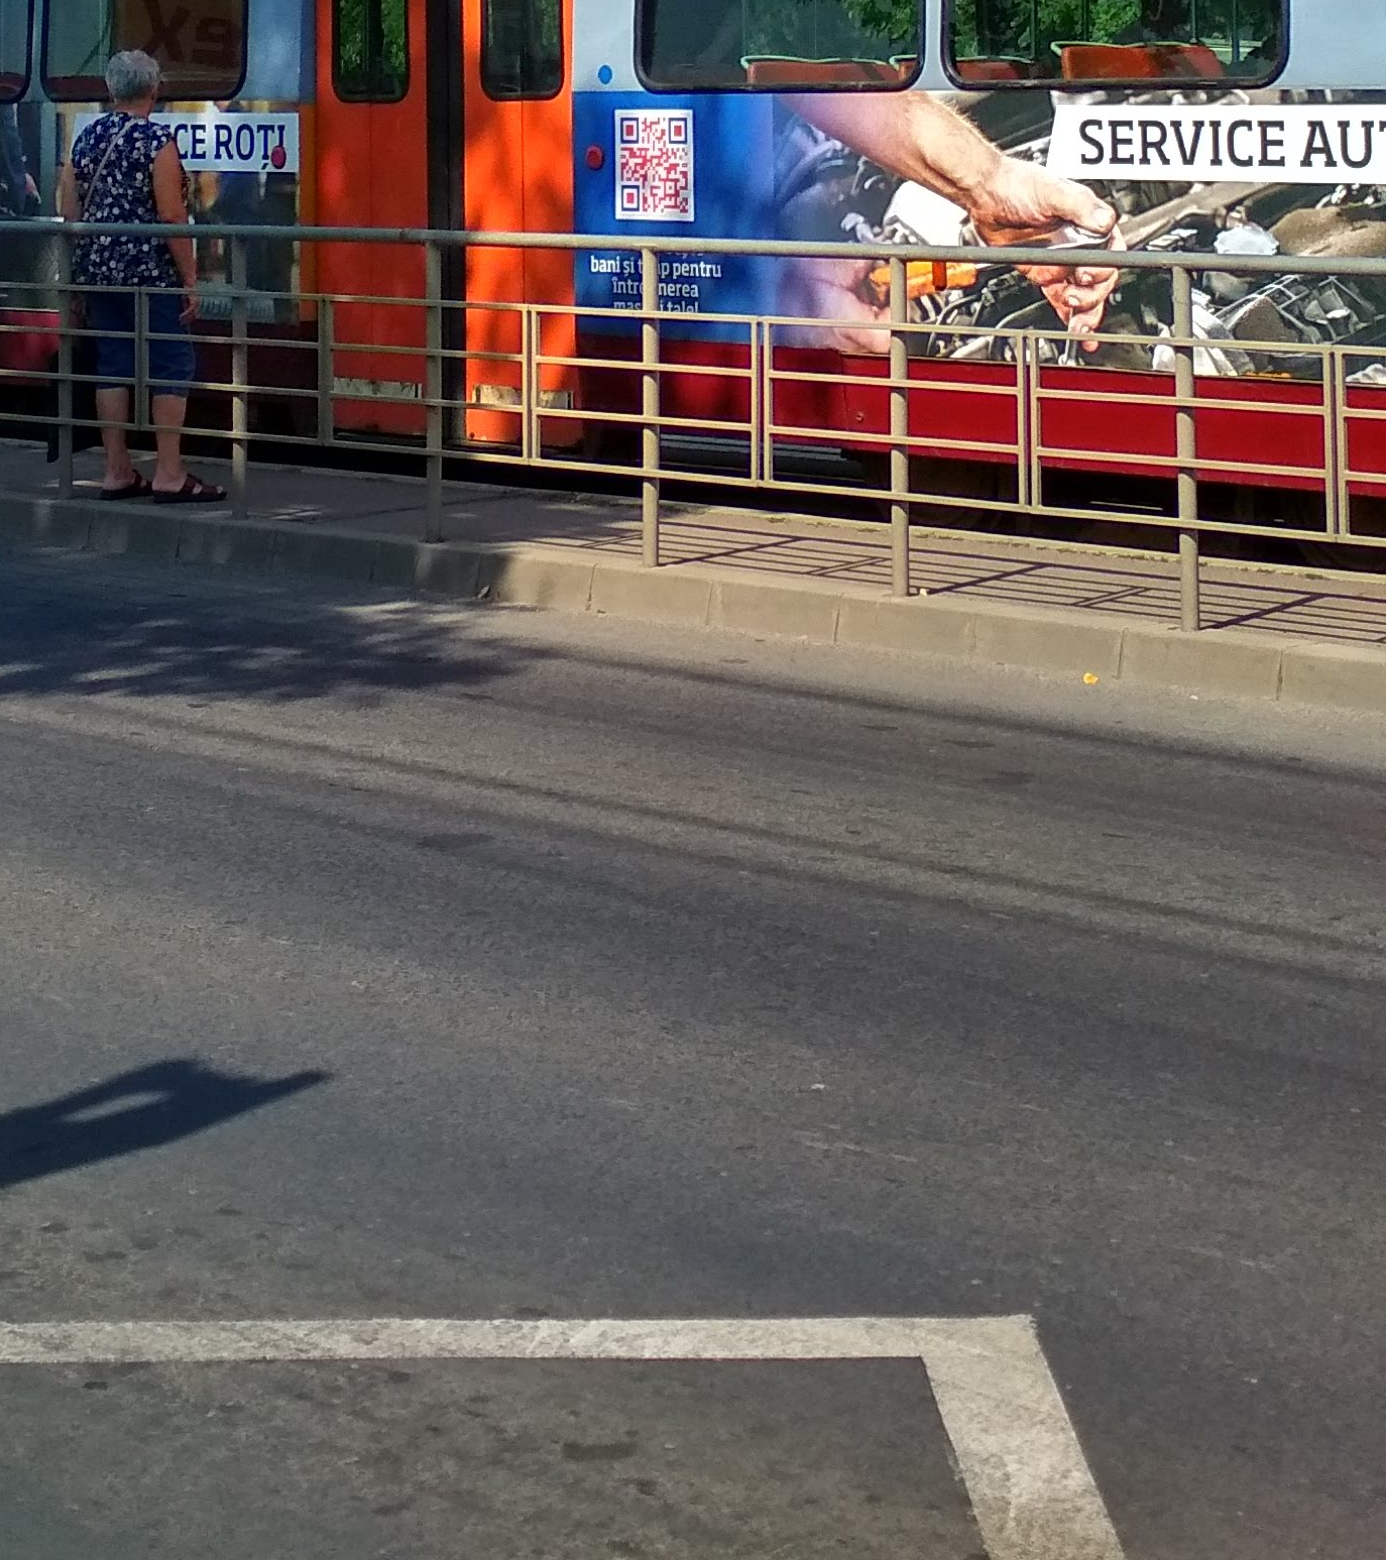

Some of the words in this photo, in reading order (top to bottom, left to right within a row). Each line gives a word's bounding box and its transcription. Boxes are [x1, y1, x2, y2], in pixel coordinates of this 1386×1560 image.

[1078, 119, 1286, 168] SERVICE
[590, 255, 621, 273] bani
[623, 256, 635, 277] și
[637, 259, 670, 279] tp
[672, 261, 722, 280] pentru
[611, 276, 699, 298] întrnerea
